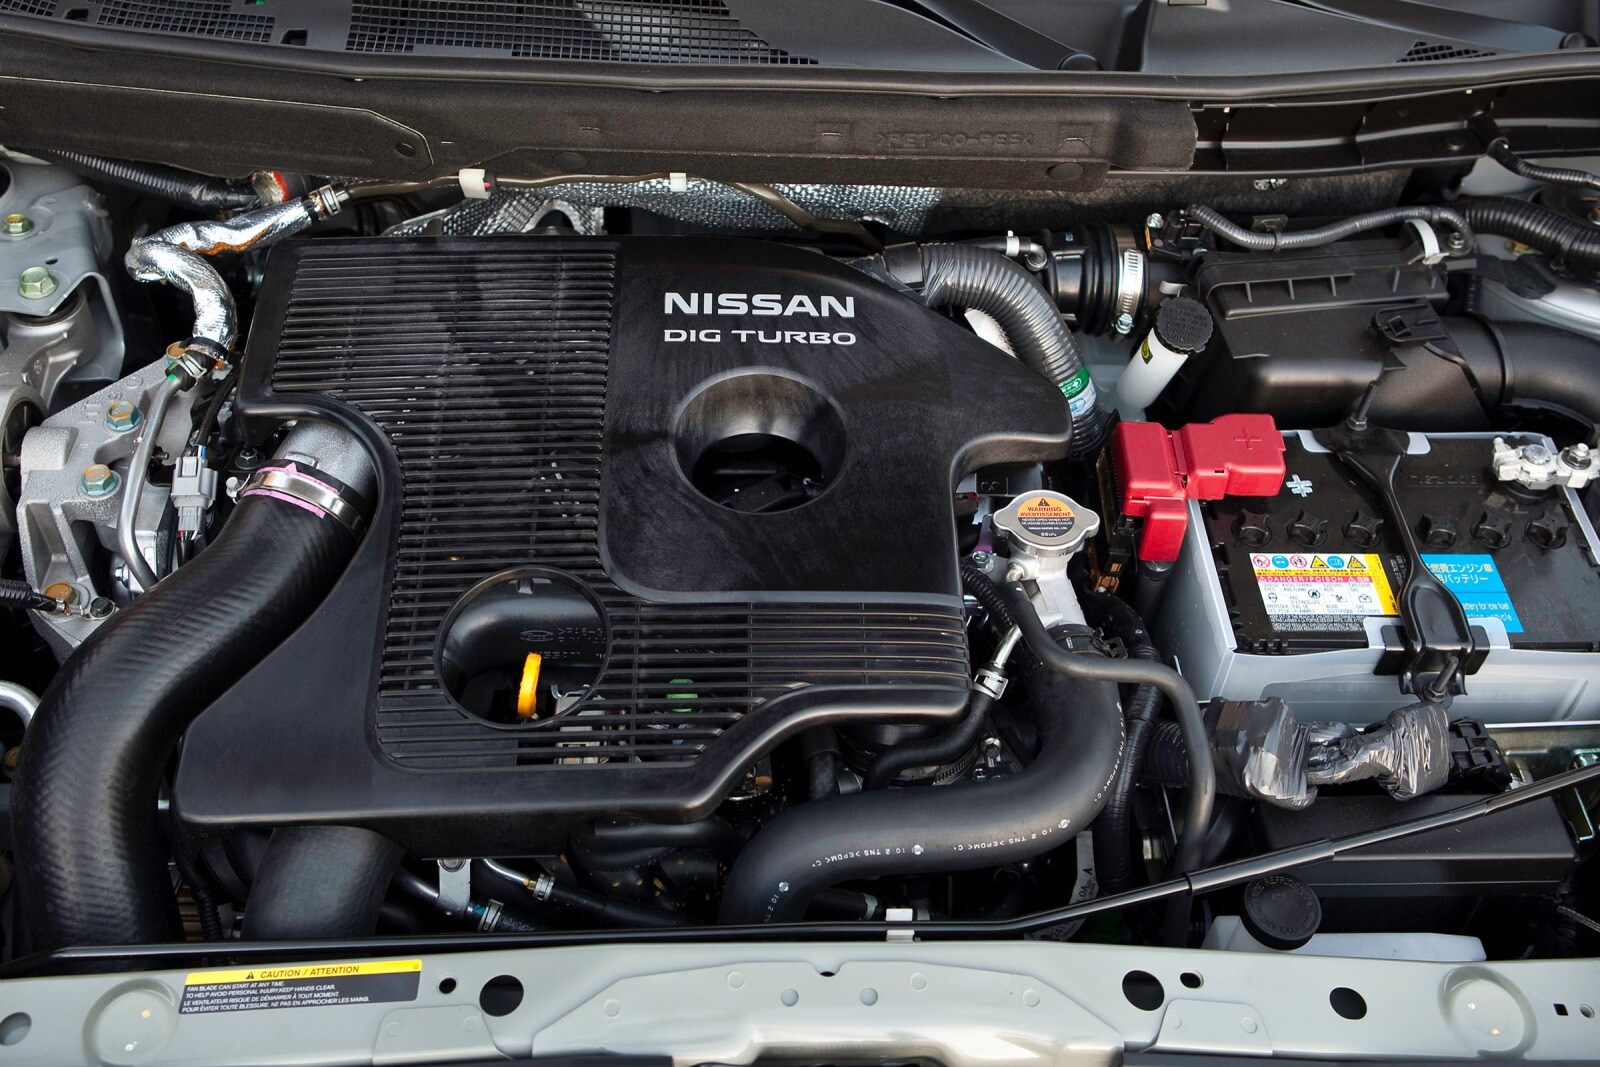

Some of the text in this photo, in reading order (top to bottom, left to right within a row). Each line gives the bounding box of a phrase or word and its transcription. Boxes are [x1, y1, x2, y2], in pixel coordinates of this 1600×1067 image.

[664, 292, 855, 318] NISSAN
[664, 329, 856, 346] DIG TURBO
[1426, 563, 1494, 573] 燃費エンジン車
[1041, 828, 1052, 836] 10
[1008, 836, 1026, 844] TNS
[864, 848, 881, 857] TNS
[260, 969, 300, 979] CAUTION
[310, 966, 359, 975] ATTENTION
